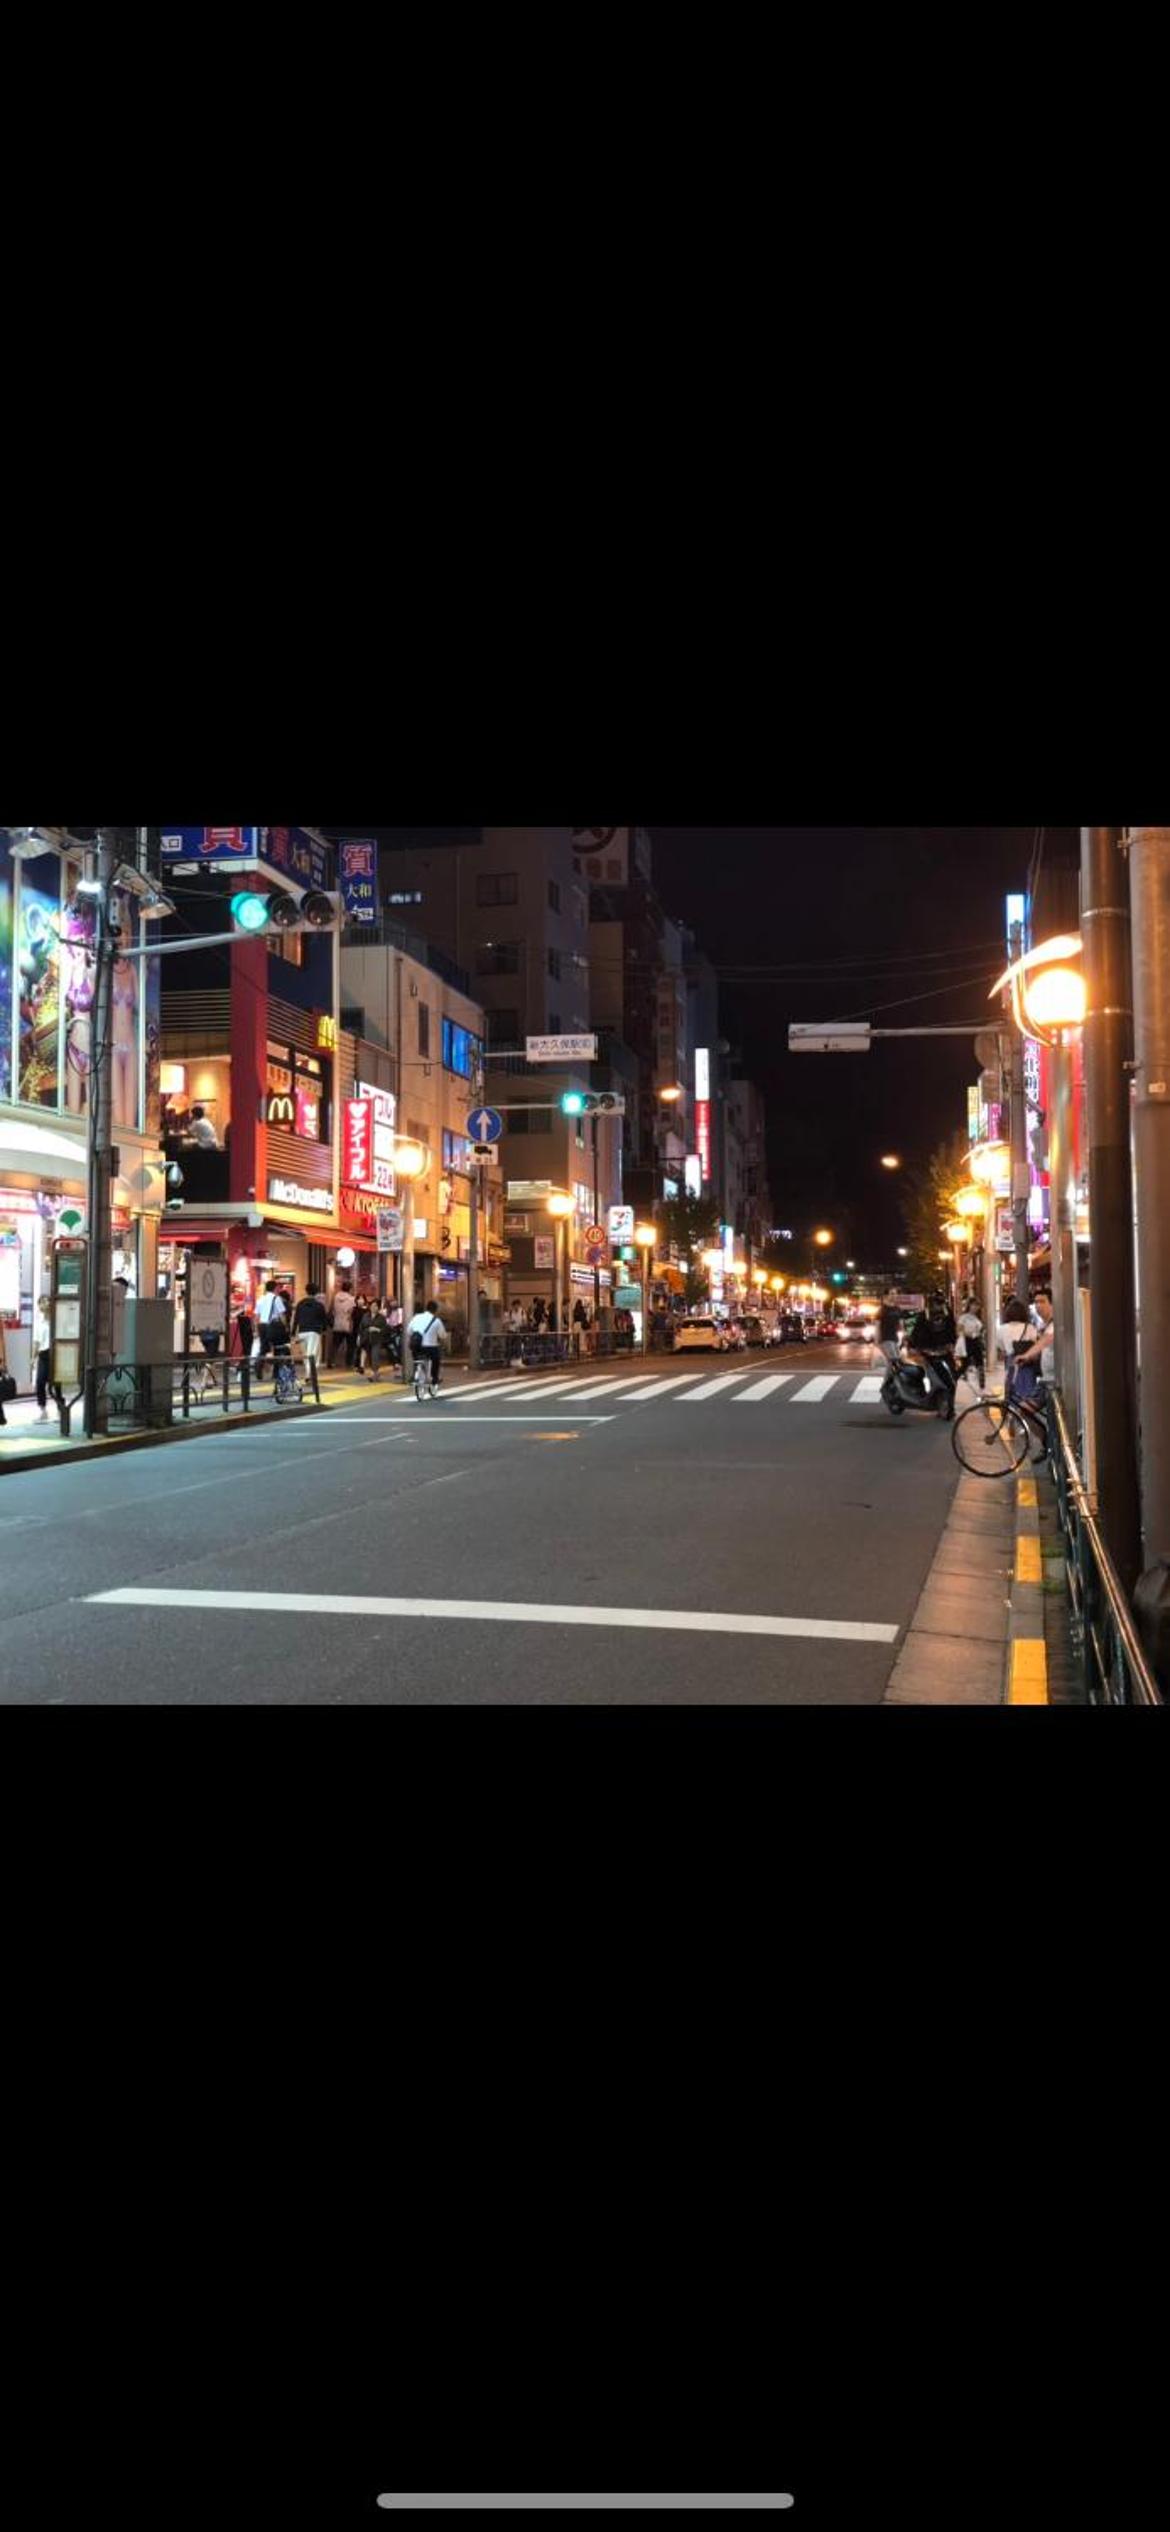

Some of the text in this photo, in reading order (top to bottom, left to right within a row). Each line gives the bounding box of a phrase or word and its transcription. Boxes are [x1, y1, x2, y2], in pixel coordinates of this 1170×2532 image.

[343, 845, 373, 878] 質
[350, 1118, 367, 1181] アイフル
